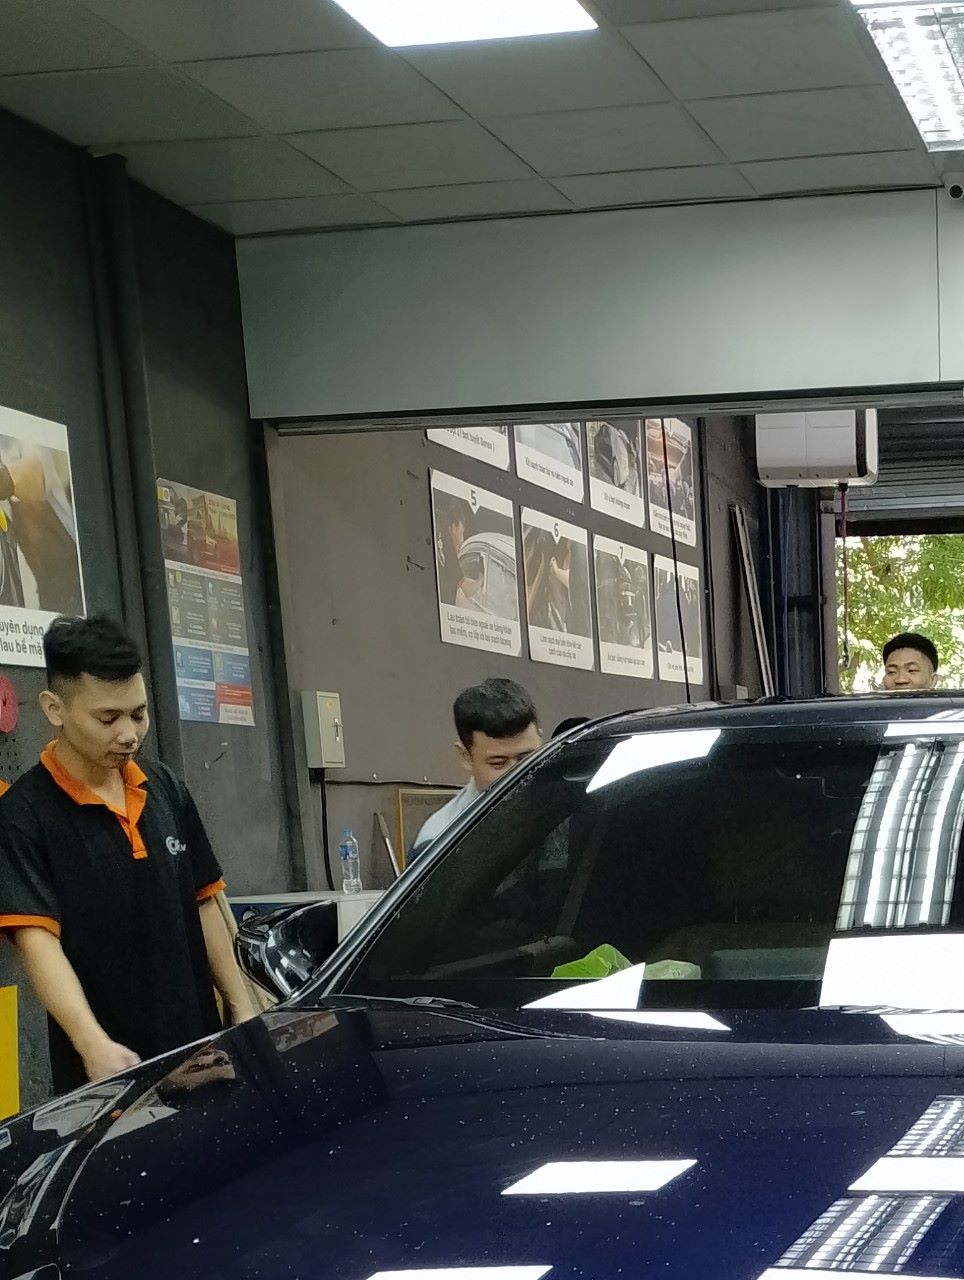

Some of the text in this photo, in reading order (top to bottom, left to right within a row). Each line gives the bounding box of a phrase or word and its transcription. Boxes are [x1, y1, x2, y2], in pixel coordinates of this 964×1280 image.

[470, 490, 477, 506] 5
[553, 522, 559, 538] 6
[29, 641, 43, 659] mặ
